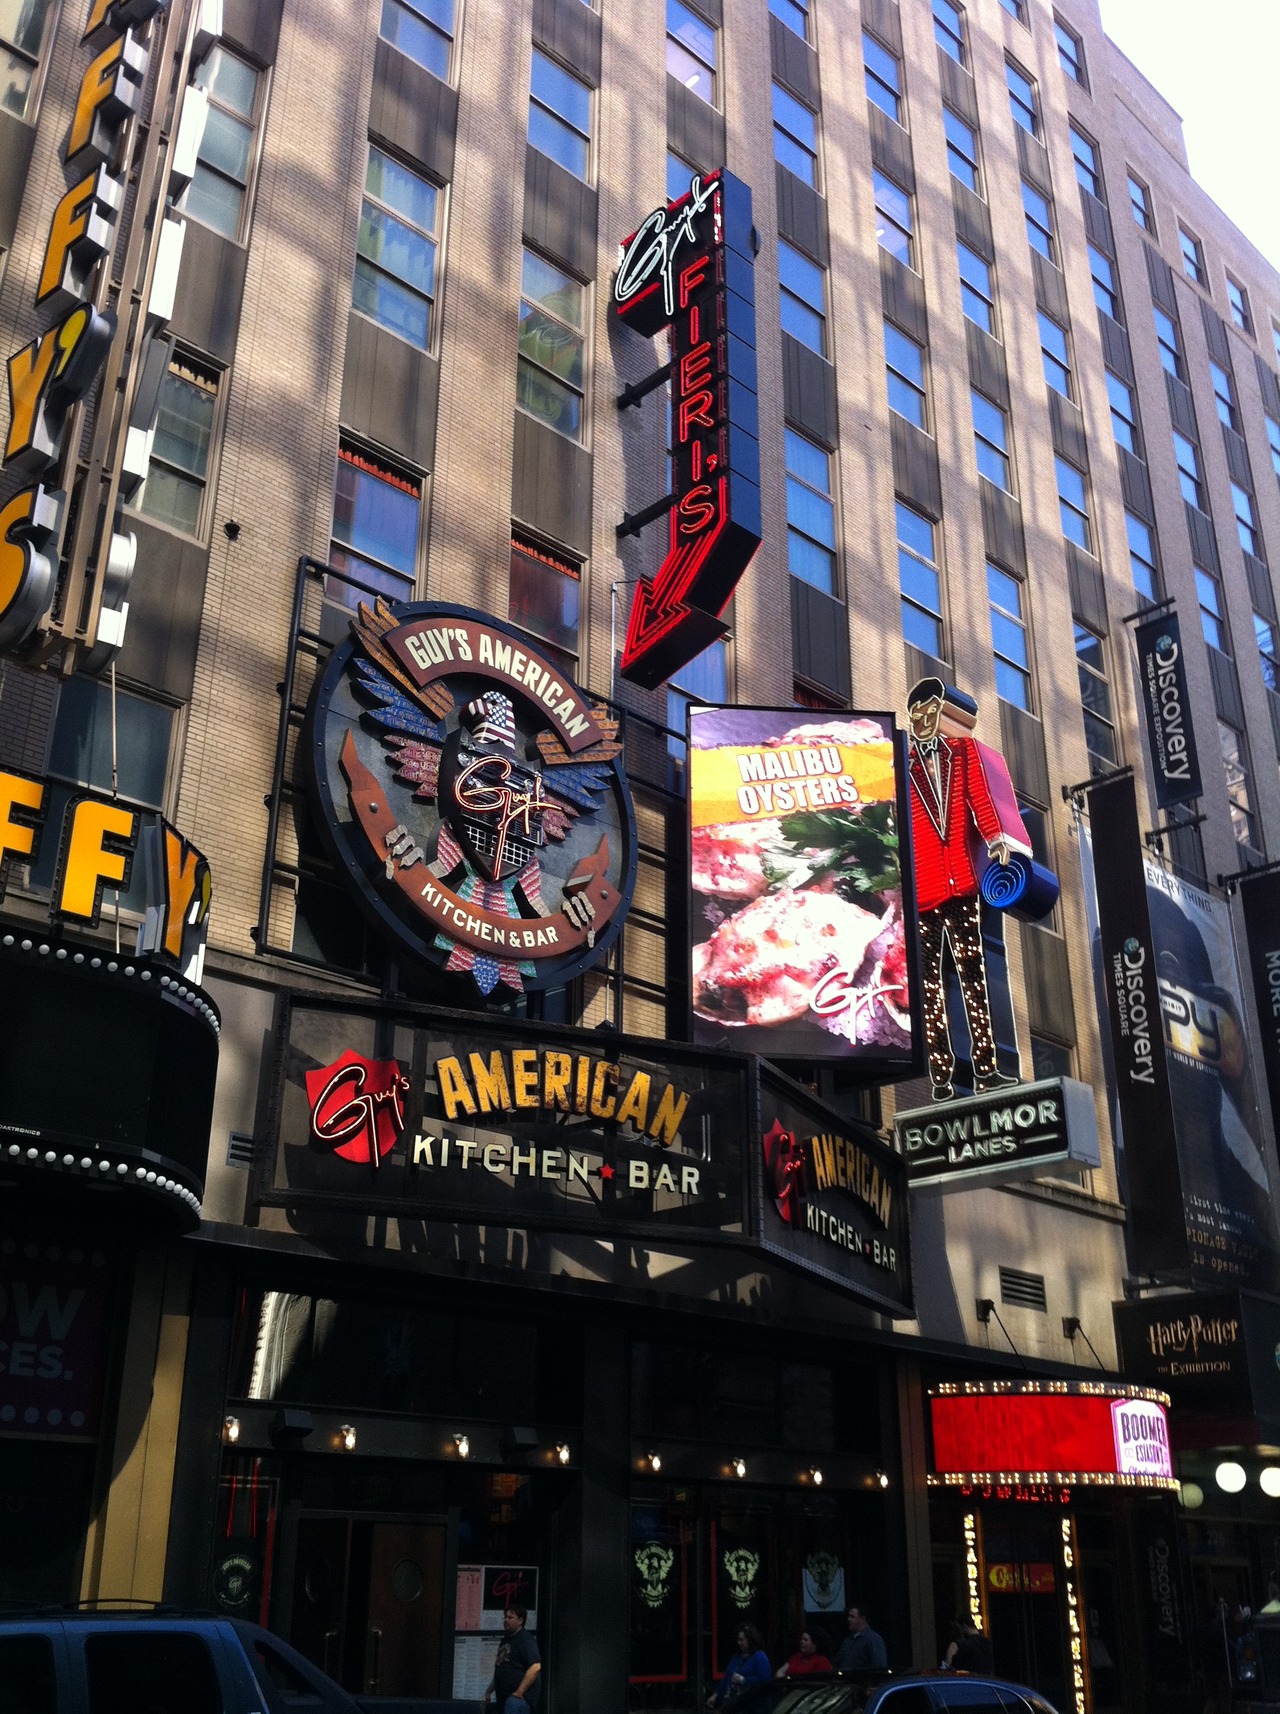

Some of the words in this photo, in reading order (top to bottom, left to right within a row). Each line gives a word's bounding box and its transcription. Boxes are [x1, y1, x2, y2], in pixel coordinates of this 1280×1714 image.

[679, 255, 718, 533] FIERI'S
[405, 628, 473, 670] GUY'S
[479, 633, 590, 738] AMERICAN
[737, 746, 843, 782] MALIBU
[737, 776, 858, 815] OYSTERS
[421, 882, 506, 948] KITCHEN
[522, 926, 559, 948] BAR
[1113, 952, 1124, 986] TIMES
[1117, 989, 1129, 1036] SQUARE
[1124, 947, 1155, 1084] Discovery
[313, 1063, 410, 1167] Guy's
[436, 1049, 691, 1147] AMERICAN
[905, 1100, 1059, 1151] BOWLMOR
[412, 1134, 589, 1183] KITCHEN
[628, 1160, 700, 1195] BAR
[948, 1135, 1017, 1163] LANES
[810, 1133, 892, 1230] AMERICAN
[806, 1202, 863, 1254] KITCHEN
[873, 1239, 897, 1272] BAR
[1147, 1319, 1191, 1357] Harry
[1189, 1313, 1238, 1360] Potter
